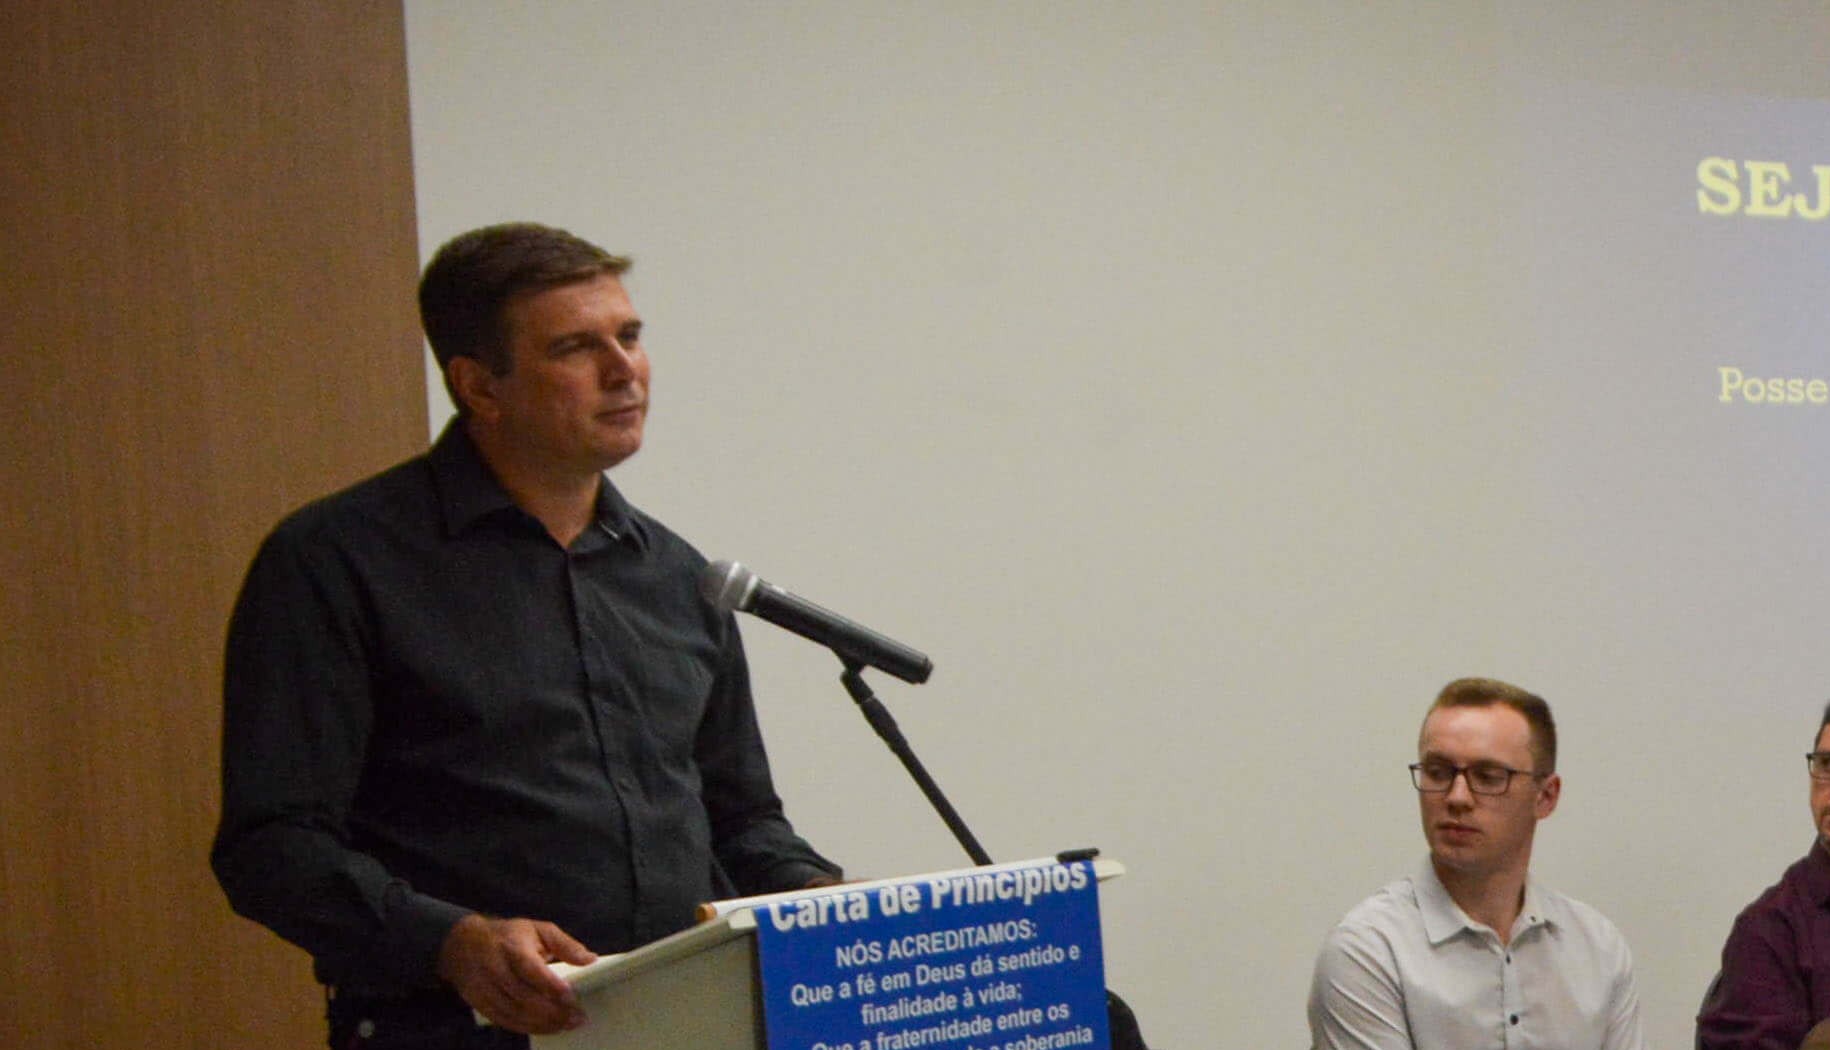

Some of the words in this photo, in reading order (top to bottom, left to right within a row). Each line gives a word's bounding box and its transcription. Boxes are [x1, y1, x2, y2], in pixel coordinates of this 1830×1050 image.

[1719, 366, 1829, 404] Posse
[768, 890, 870, 931] Carta
[879, 884, 922, 917] de
[836, 940, 883, 967] NÓS
[887, 918, 1035, 960] ACREDITAMOS:
[790, 983, 834, 1006] Que
[839, 981, 851, 998] a
[855, 973, 876, 995] fé
[881, 971, 911, 991] em
[915, 963, 966, 986] Deus
[970, 954, 994, 977] dá
[997, 944, 1065, 972] sentido
[1068, 944, 1079, 960] e
[861, 991, 957, 1024] finalidade
[962, 987, 974, 1007] à
[978, 981, 1021, 1004] vida;
[996, 1007, 1042, 1030] entre
[1047, 1003, 1069, 1021] os
